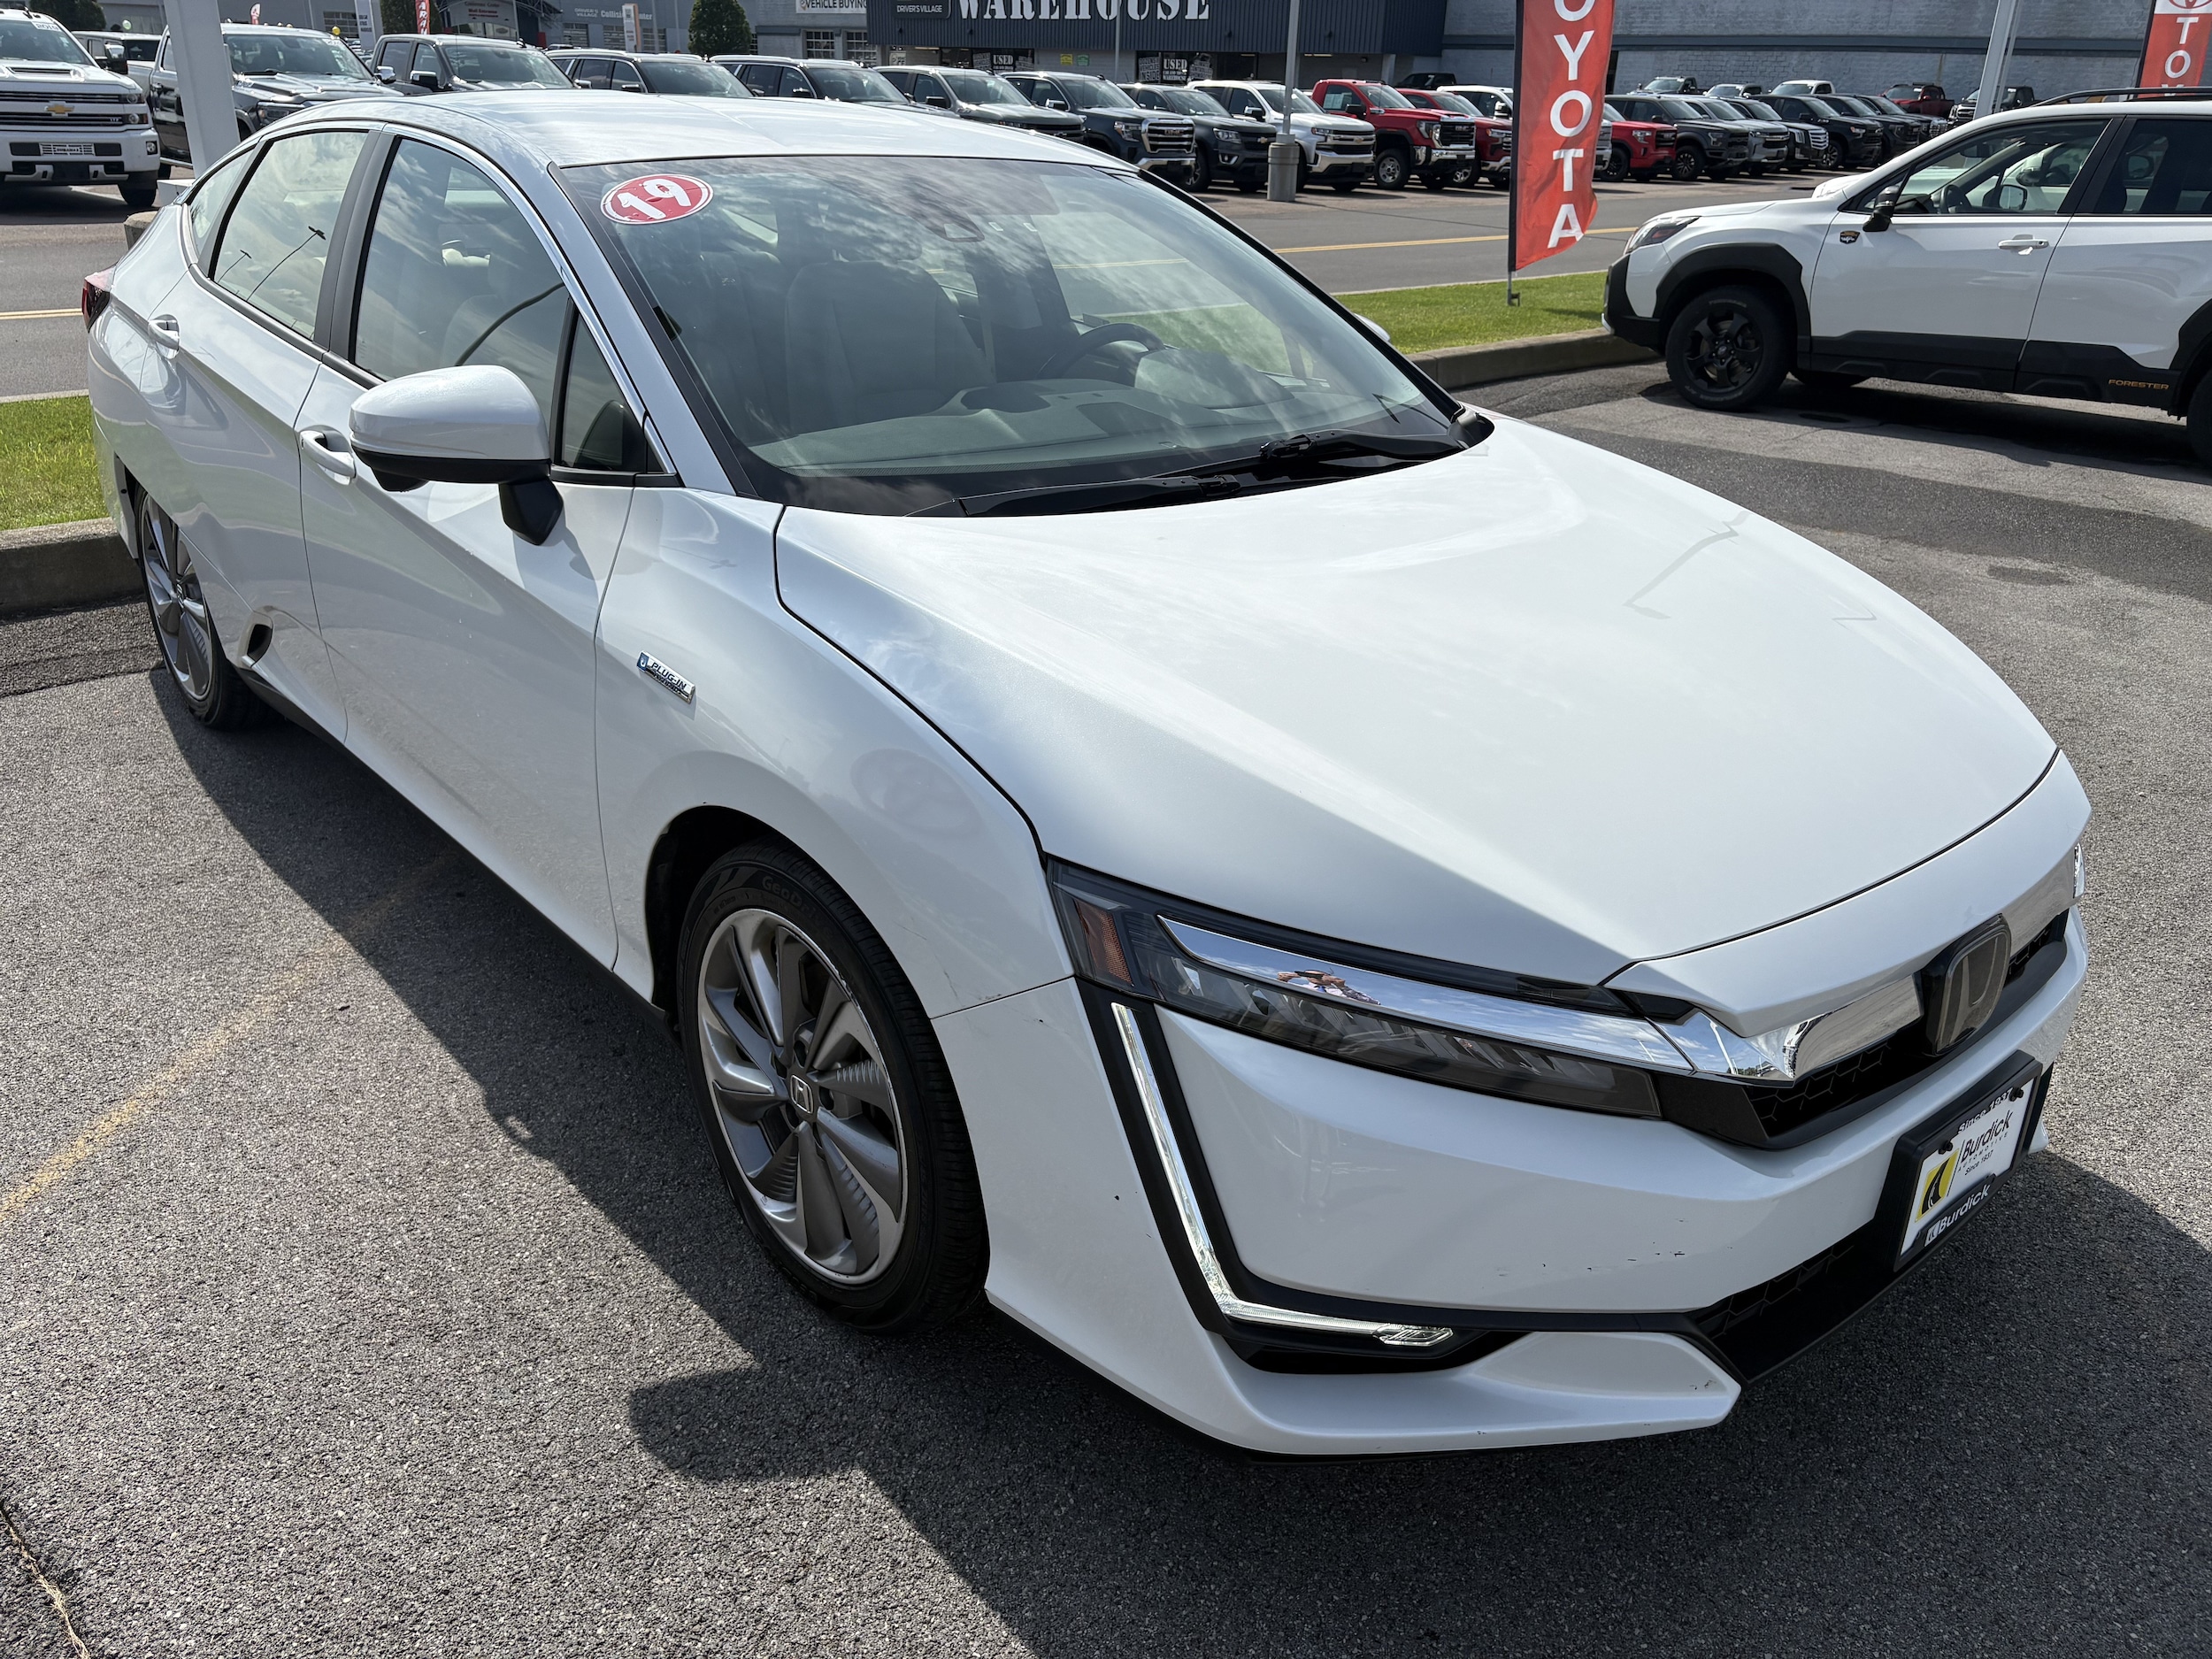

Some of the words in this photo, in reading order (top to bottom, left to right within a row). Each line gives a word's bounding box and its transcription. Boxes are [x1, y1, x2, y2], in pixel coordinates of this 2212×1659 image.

[805, 0, 837, 9] VEHICLE
[920, 4, 943, 13] VILLAGE
[993, 54, 1014, 65] USED
[1163, 58, 1188, 70] USED
[617, 178, 692, 219] 19
[2108, 379, 2170, 390] FORESTER
[650, 662, 687, 690] PLUG-IN
[1958, 1109, 1987, 1134] Since
[1961, 1110, 2014, 1164] Burdick
[1957, 1132, 2008, 1173] AUTOMOTIVE
[1964, 1161, 1980, 1176] Since
[1938, 1184, 1991, 1235] Burdick
